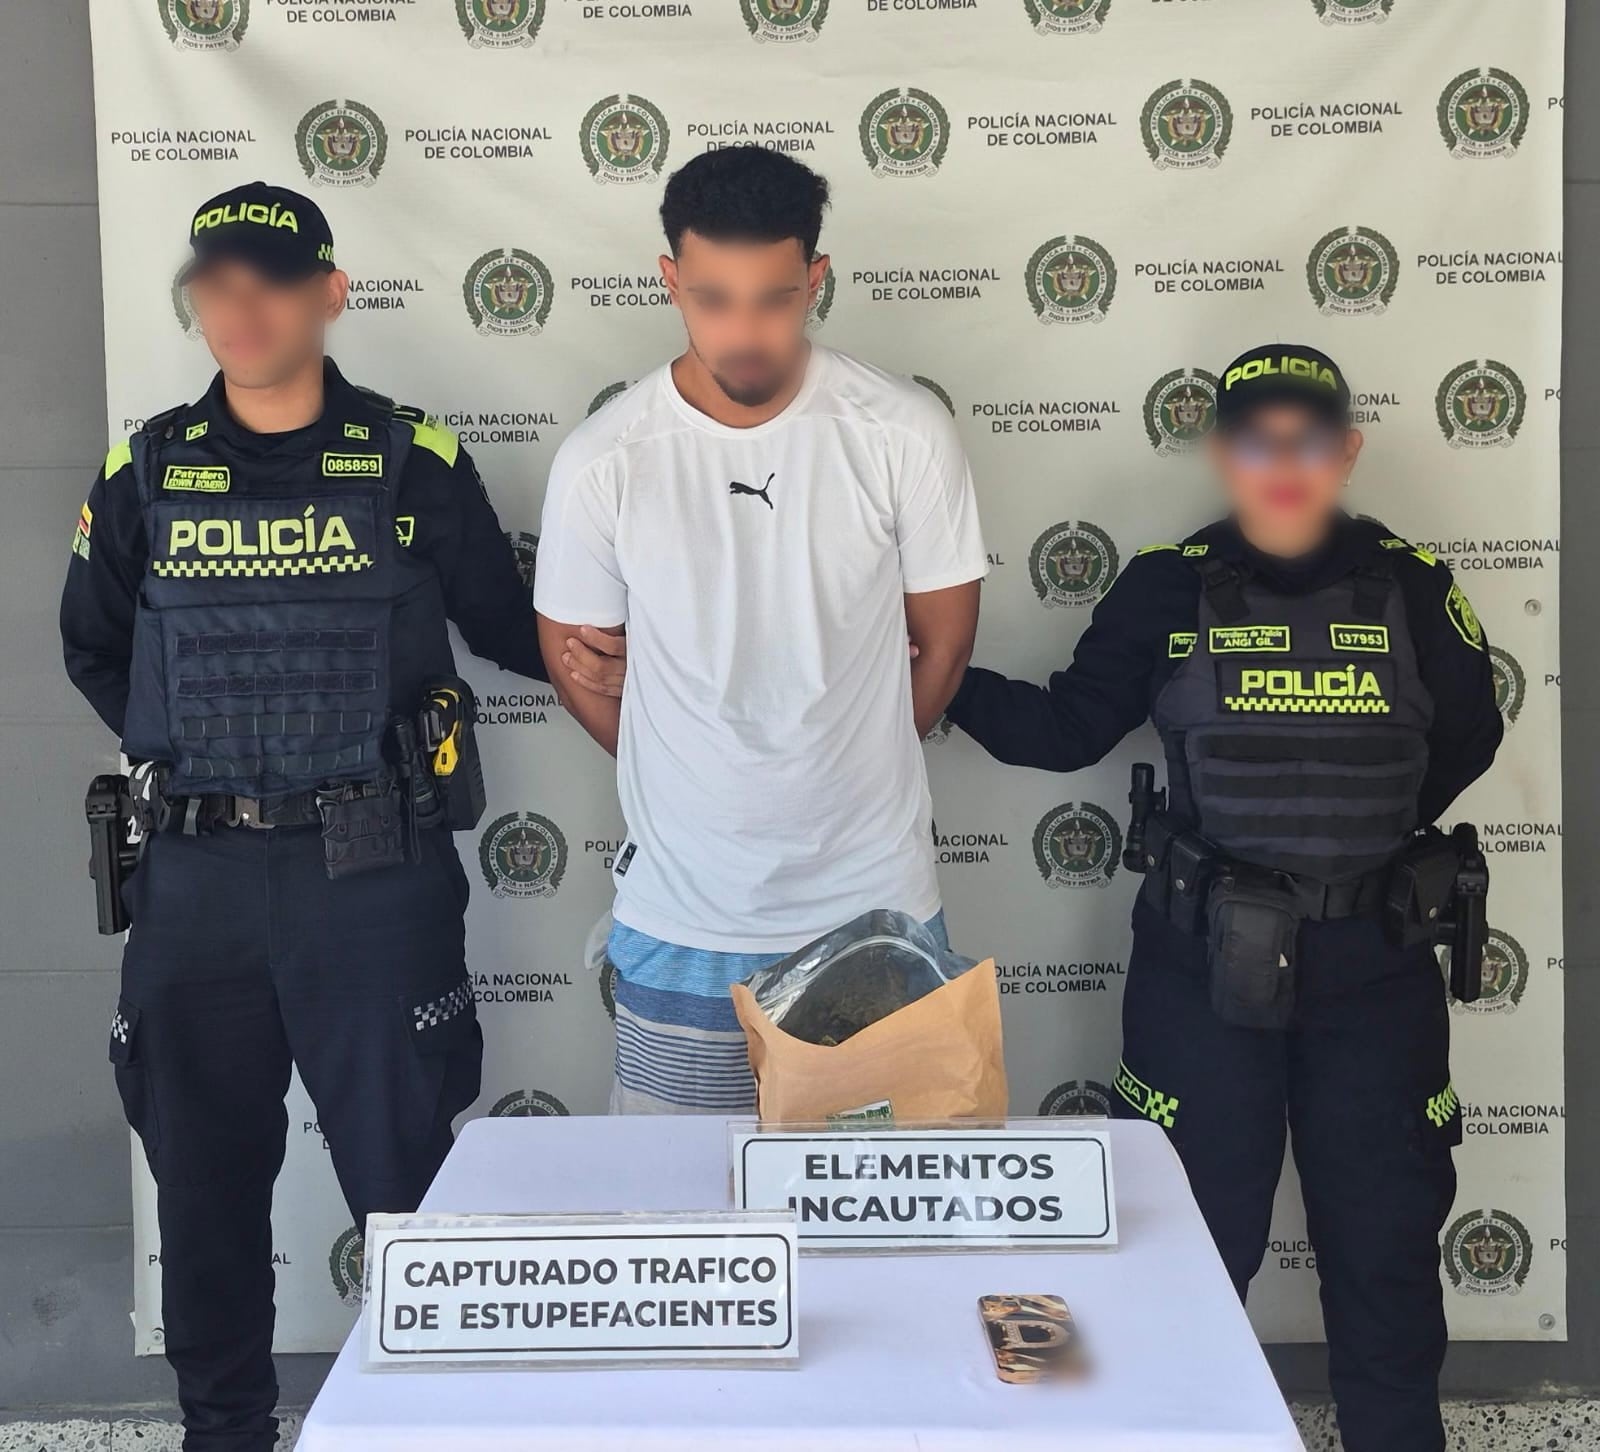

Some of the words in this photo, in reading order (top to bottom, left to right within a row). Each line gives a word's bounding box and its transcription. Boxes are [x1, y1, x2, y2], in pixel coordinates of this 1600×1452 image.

[584, 6, 604, 18] DE
[609, 4, 692, 17] COLOMBIA
[868, 0, 888, 11] DE
[894, 0, 977, 10] COLOMBIA
[287, 10, 308, 22] DE
[312, 9, 396, 22] COLOMBIA
[1252, 103, 1315, 120] POLICÍA
[1320, 102, 1402, 117] NACIONAL
[688, 120, 749, 136] POLICÍA
[754, 121, 834, 134] NACIONAL
[968, 113, 1030, 129] POLICÍA
[1035, 113, 1117, 127] NACIONAL
[1271, 124, 1292, 136] DE
[1298, 120, 1382, 135] COLOMBIA
[111, 128, 171, 144] POLICÍA
[177, 130, 256, 143] NACIONAL
[405, 126, 467, 142] POLICÍA
[472, 127, 552, 141] NACIONAL
[987, 134, 1008, 146] DE
[1013, 131, 1097, 145] COLOMBIA
[131, 149, 151, 161] DE
[155, 148, 239, 161] COLOMBIA
[425, 147, 445, 159] DE
[450, 146, 533, 158] COLOMBIA
[194, 202, 298, 236] POLICÍA
[1418, 251, 1479, 267] POLICÍA
[1135, 259, 1198, 276] POLICÍA
[1203, 259, 1284, 274] NACIONAL
[571, 274, 632, 289] POLICÍA
[853, 268, 914, 285] POLICÍA
[920, 269, 1000, 282] NACIONAL
[1436, 272, 1457, 284] DE
[1462, 270, 1545, 283] COLOMBIA
[1155, 280, 1175, 292] DE
[1181, 278, 1264, 291] COLOMBIA
[591, 295, 611, 306] DE
[616, 293, 672, 306] COLOM
[873, 288, 893, 301] DE
[898, 286, 981, 300] COLOMBIA
[346, 297, 405, 310] LOMBIA
[1353, 393, 1400, 406] IONAL
[973, 400, 1034, 417] POLICÍA
[1039, 401, 1120, 415] NACIONAL
[444, 411, 474, 426] ICÍA
[479, 413, 558, 426] NACIONAL
[992, 421, 1012, 433] DE
[1018, 419, 1101, 432] COLOMBIA
[458, 431, 540, 443] COLOMBIA
[328, 459, 378, 472] 085859
[173, 470, 224, 480] Patrullero
[195, 480, 226, 489] ROMERO
[170, 505, 356, 556] POLICÍA
[1461, 557, 1544, 570] COLOMBIA
[1224, 638, 1251, 647] ANGI
[1256, 637, 1274, 646] GIL
[1338, 633, 1383, 645] 137953
[1241, 663, 1381, 698] POLICÍA
[478, 712, 548, 724] OLOMBIA
[1484, 824, 1562, 836] NACIONAL
[585, 840, 625, 852] POLI
[1478, 840, 1546, 852] LOMBIA
[604, 857, 614, 868] D
[935, 851, 989, 863] OMBIA
[995, 962, 1041, 978] OLICÍA
[1047, 962, 1125, 976] NACIONAL
[493, 973, 572, 986] NACIONAL
[1000, 982, 1020, 994] DE
[1025, 979, 1106, 993] COLOMBIA
[473, 990, 554, 1002] COLOMBIA
[1488, 1105, 1565, 1118] NACIONAL
[1466, 1122, 1548, 1134] COLOMBIA
[804, 1152, 1054, 1181] ELEMENTOS
[1280, 1258, 1300, 1269] DE
[404, 1257, 618, 1288] CAPTURADO
[628, 1255, 777, 1285] TRAFICO
[394, 1302, 440, 1331] DE
[460, 1298, 778, 1330] ESTUPEFACIENTES
